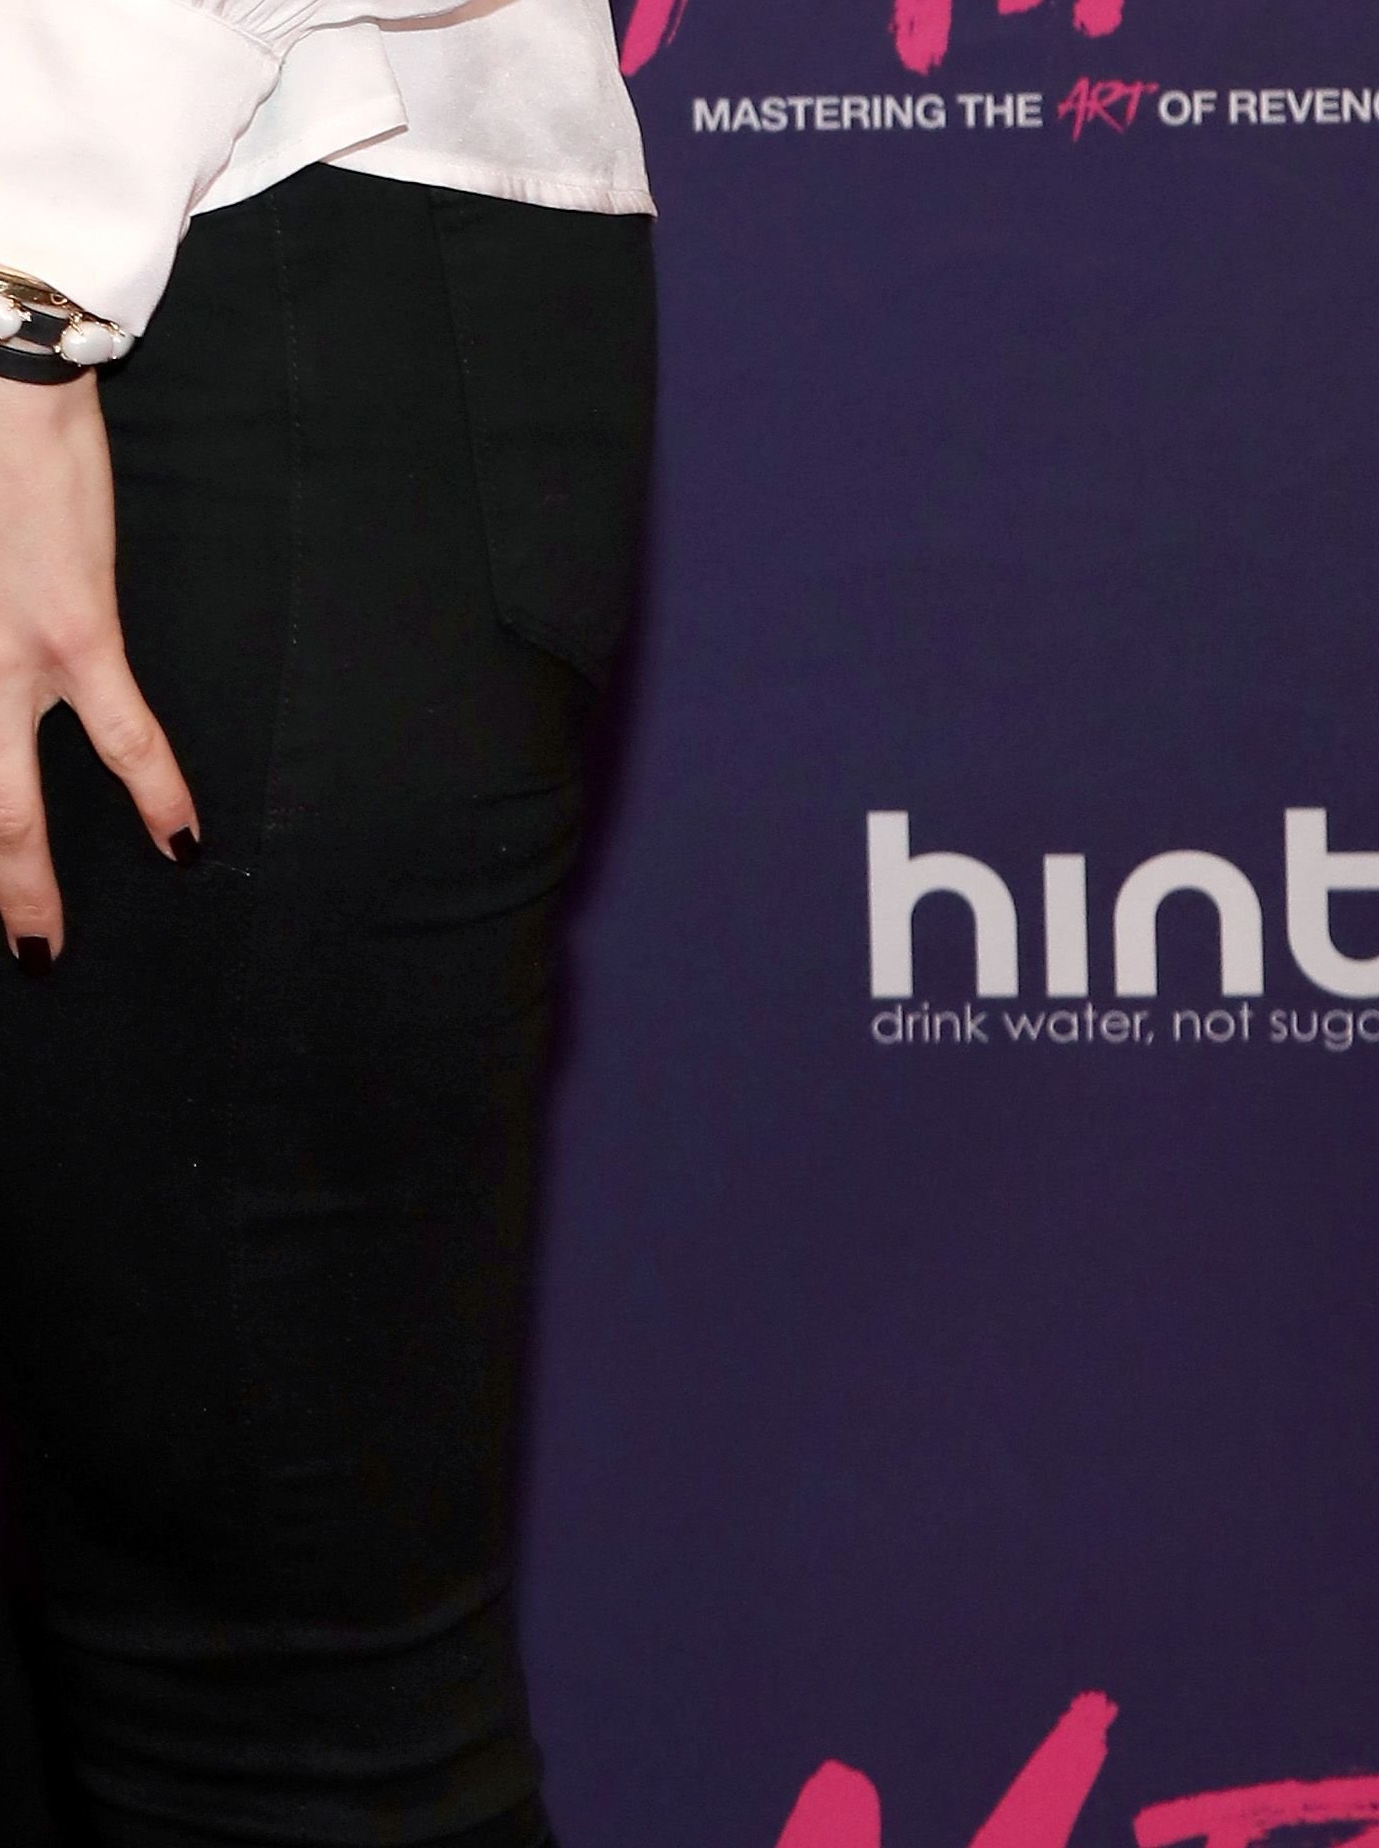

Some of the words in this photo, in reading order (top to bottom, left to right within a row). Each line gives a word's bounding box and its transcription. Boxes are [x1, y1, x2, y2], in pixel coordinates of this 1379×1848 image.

[692, 94, 947, 133] MASTERING
[958, 93, 1044, 128] THE
[1057, 76, 1159, 142] ART
[1157, 89, 1218, 127] OF
[1228, 86, 1379, 126] REVEN
[870, 1002, 990, 1044] drink
[1002, 1002, 1155, 1046] water,
[1172, 1000, 1255, 1044] not
